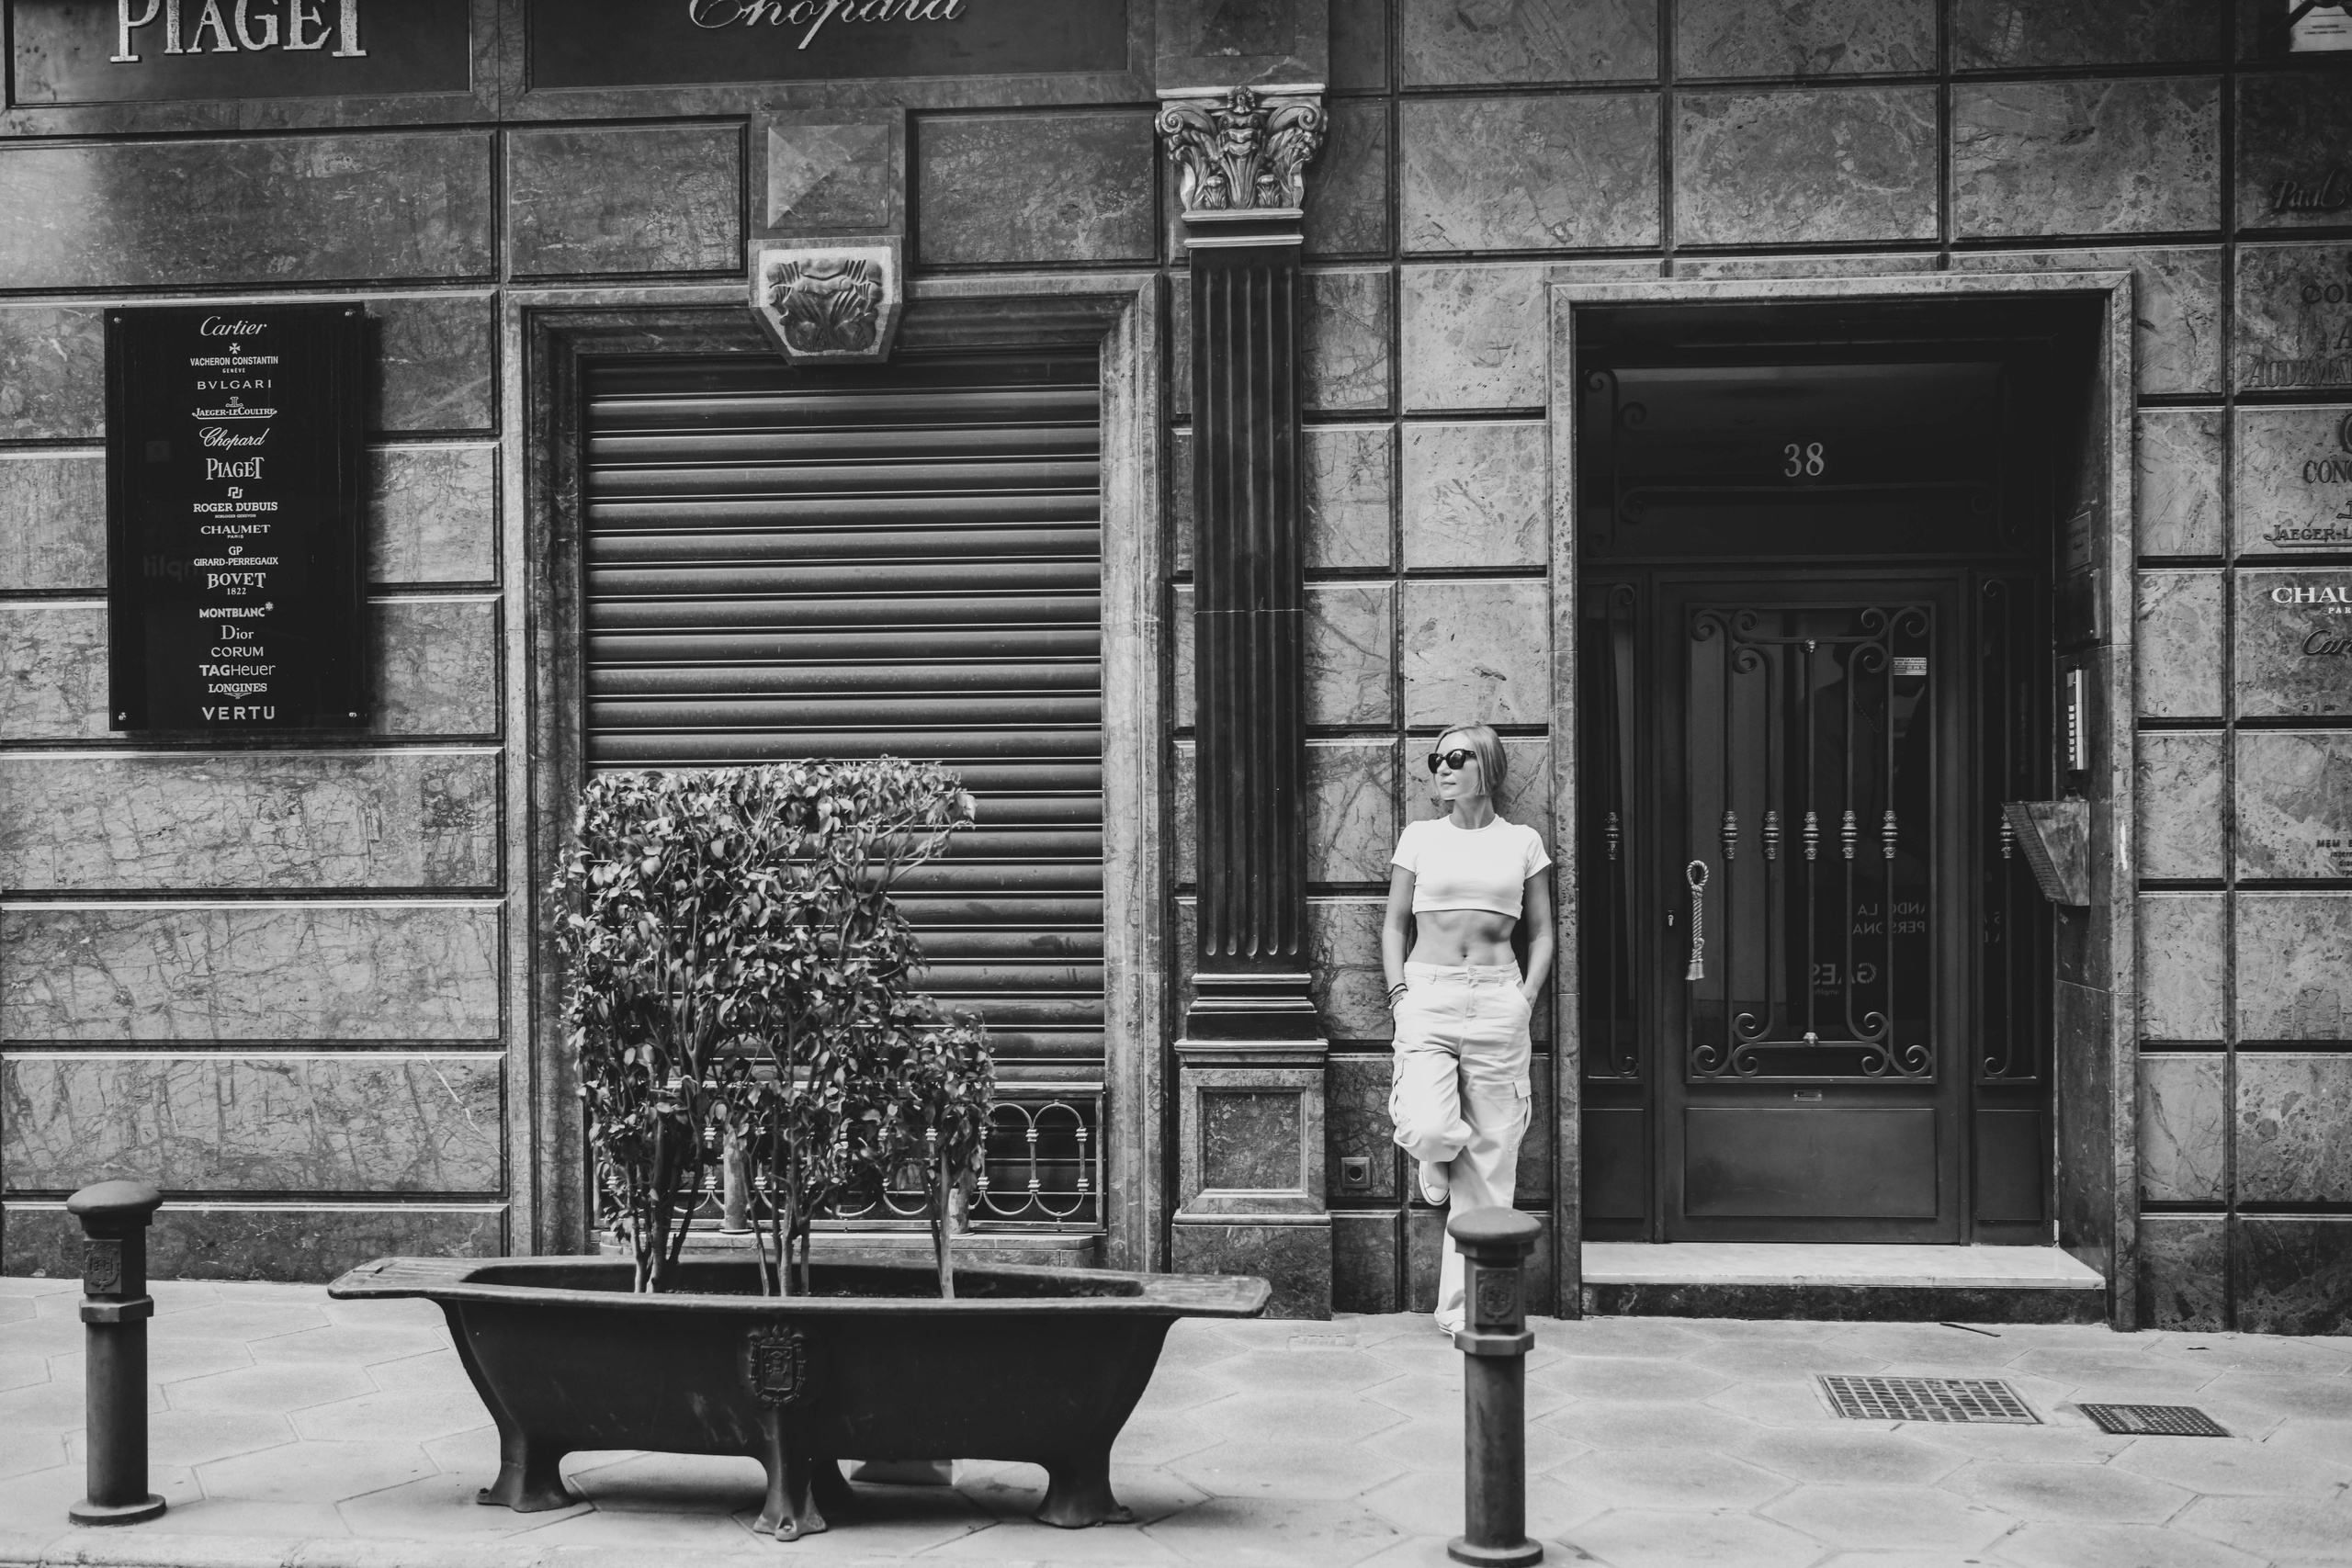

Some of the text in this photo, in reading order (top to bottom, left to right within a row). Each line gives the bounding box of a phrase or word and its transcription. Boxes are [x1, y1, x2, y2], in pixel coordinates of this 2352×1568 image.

[689, 0, 967, 50] opar
[200, 315, 267, 336] Cartier
[190, 355, 278, 367] VACHERON CONSTANTIN
[197, 379, 272, 390] BVLGARI
[199, 426, 270, 450] Chopard
[1783, 442, 1825, 478] 38
[206, 457, 265, 480] PIAGET
[193, 502, 278, 513] ROGER DUBUIS
[200, 525, 271, 535] CHAUMET
[193, 557, 278, 567] GIRARD-PERREGAUX
[207, 572, 266, 590] BOVET
[226, 587, 247, 596] 1822
[198, 607, 266, 619] MONTBLANC
[220, 625, 254, 640] Dior
[210, 647, 265, 658] CORUM
[198, 664, 277, 677] TAGHeuer
[208, 682, 268, 694] LONGINES
[201, 705, 277, 721] VERTU
